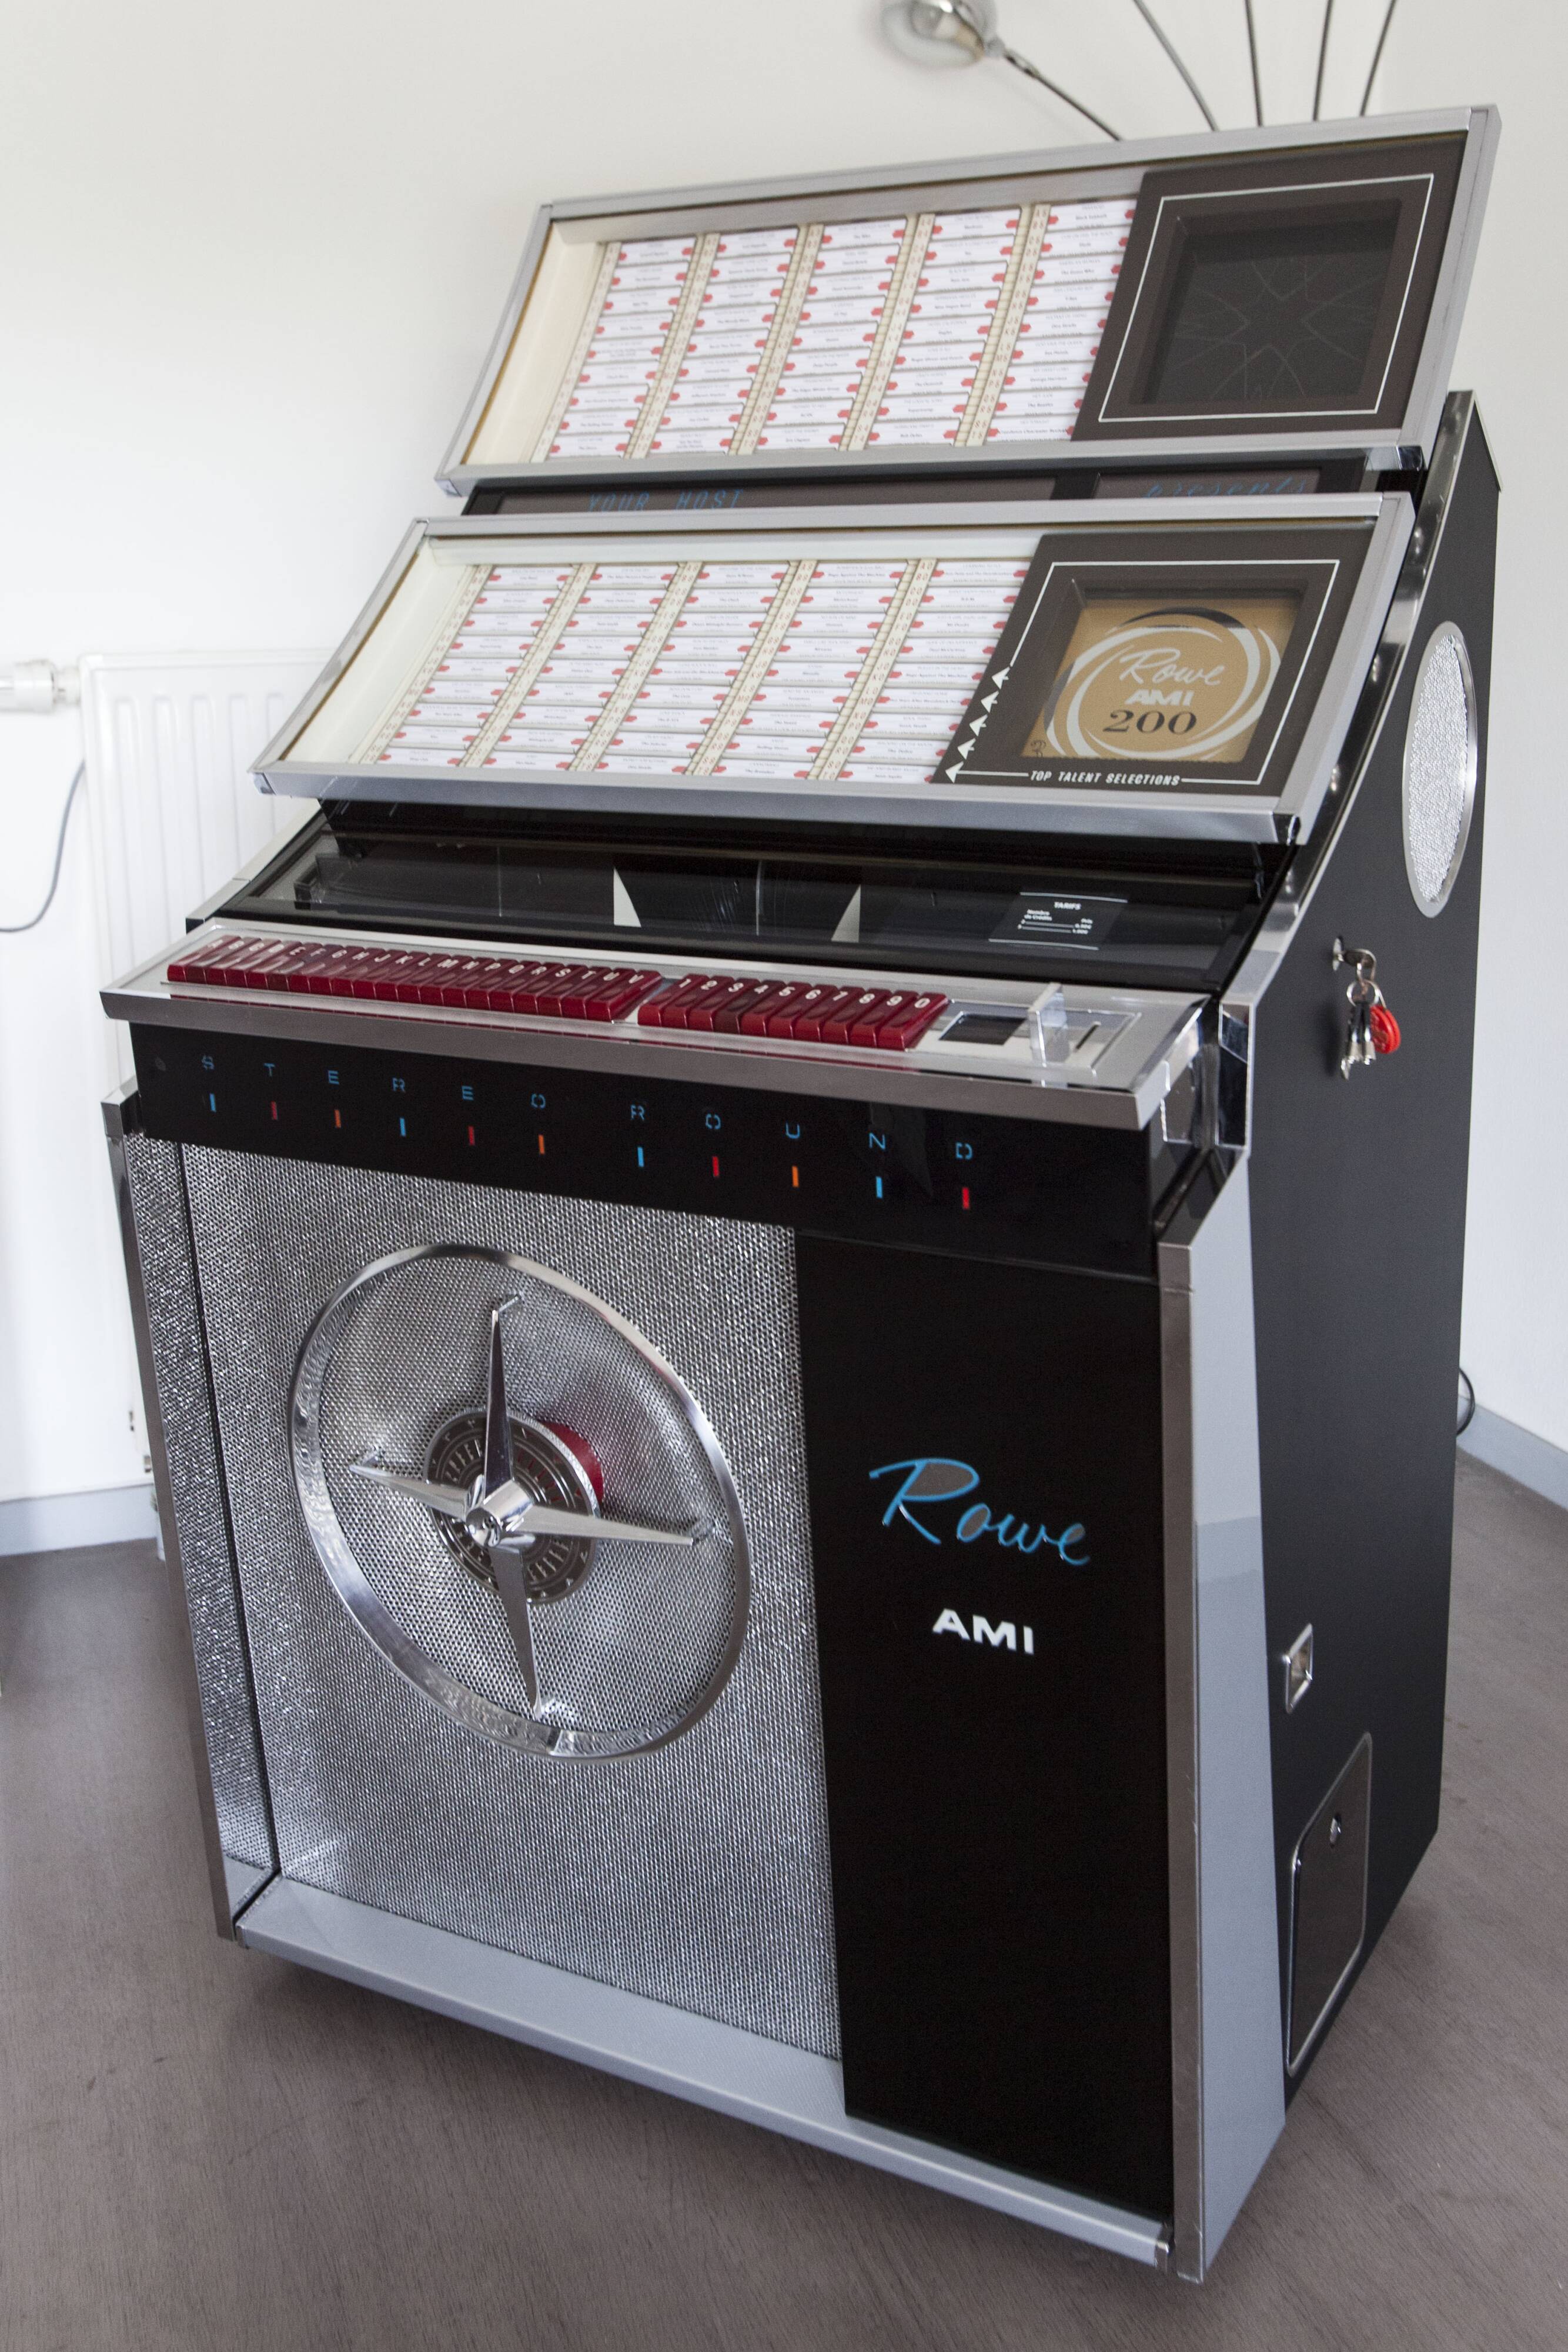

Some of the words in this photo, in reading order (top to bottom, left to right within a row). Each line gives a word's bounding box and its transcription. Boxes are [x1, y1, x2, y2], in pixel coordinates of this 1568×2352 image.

[587, 490, 650, 512] YOUR
[676, 489, 744, 510] HOST
[1119, 648, 1225, 686] Rowe
[1124, 689, 1193, 707] AMI
[1102, 709, 1198, 736] 200
[1029, 770, 1052, 782] TOP
[1058, 770, 1101, 784] TALENT
[1106, 773, 1181, 786] SELECTIONS
[1054, 901, 1082, 910] TARIFS
[352, 951, 370, 961] H
[374, 953, 392, 963] J
[395, 955, 414, 965] K
[417, 957, 432, 967] L
[437, 958, 459, 969] M
[484, 963, 502, 971] P
[530, 965, 547, 975] R
[554, 968, 571, 978] S
[581, 970, 597, 980] T
[678, 978, 693, 988] 1
[700, 980, 718, 991] 2
[728, 982, 744, 993] 3
[753, 984, 770, 995] 4
[778, 986, 796, 997] 5
[805, 989, 822, 1000] 6
[832, 990, 849, 1001] 7
[859, 993, 876, 1004] 8
[886, 995, 903, 1006] 9
[914, 997, 931, 1008] 0
[869, 1458, 1091, 1565] Rowe
[932, 1608, 1034, 1656] AMI
